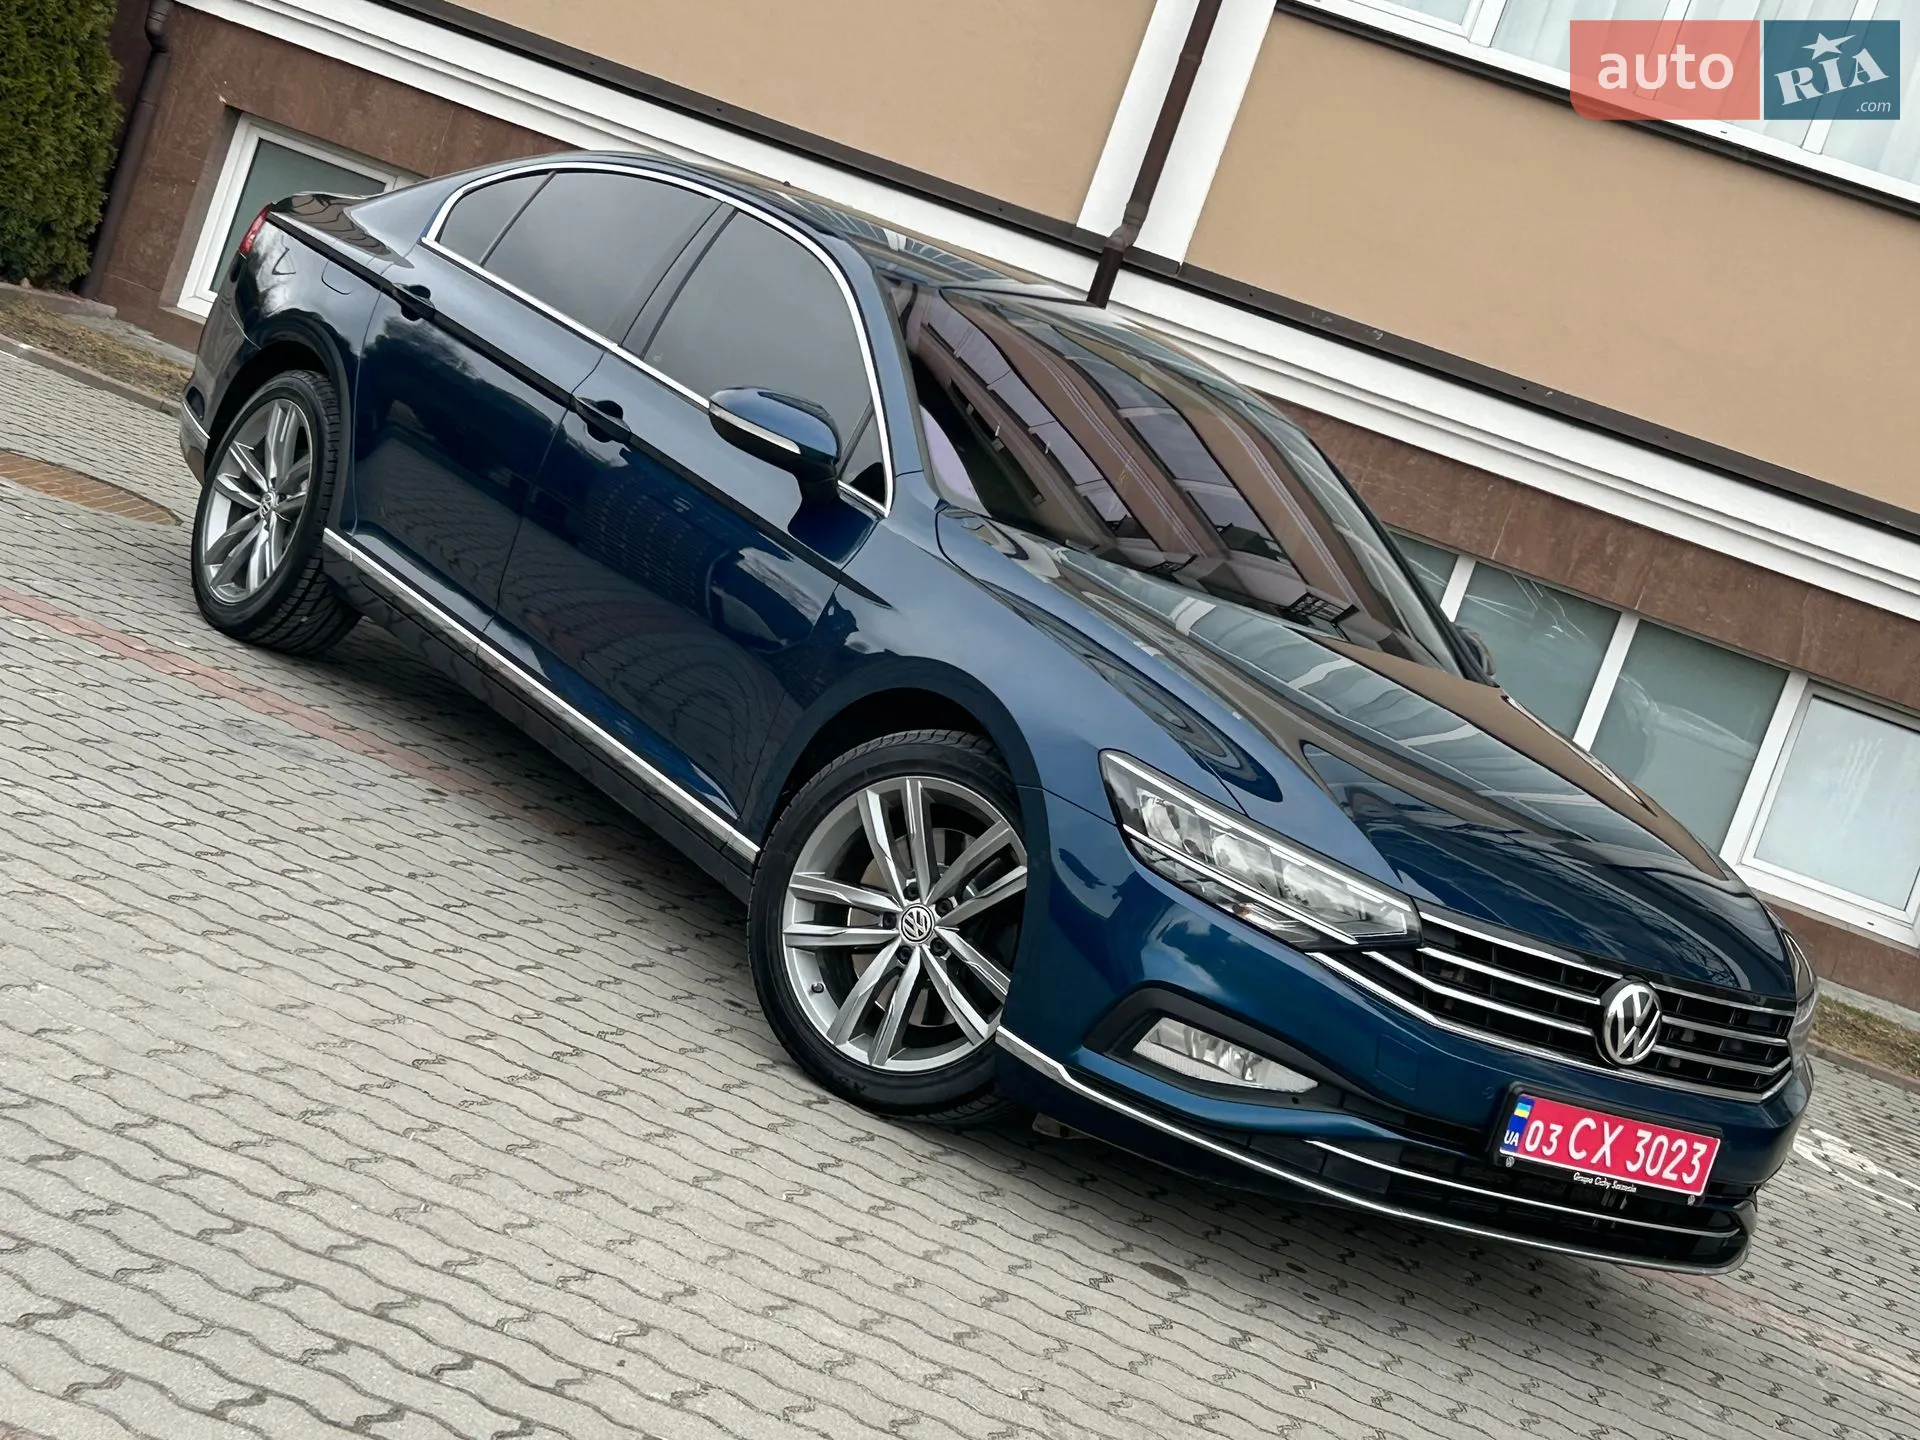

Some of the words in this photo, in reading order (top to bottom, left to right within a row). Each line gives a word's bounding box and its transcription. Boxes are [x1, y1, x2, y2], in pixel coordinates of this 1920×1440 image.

[1604, 983, 1660, 1065] VW
[1503, 1129, 1520, 1147] UA
[1524, 1119, 1563, 1156] 03
[1568, 1117, 1624, 1168] CX
[1625, 1129, 1708, 1184] 3023
